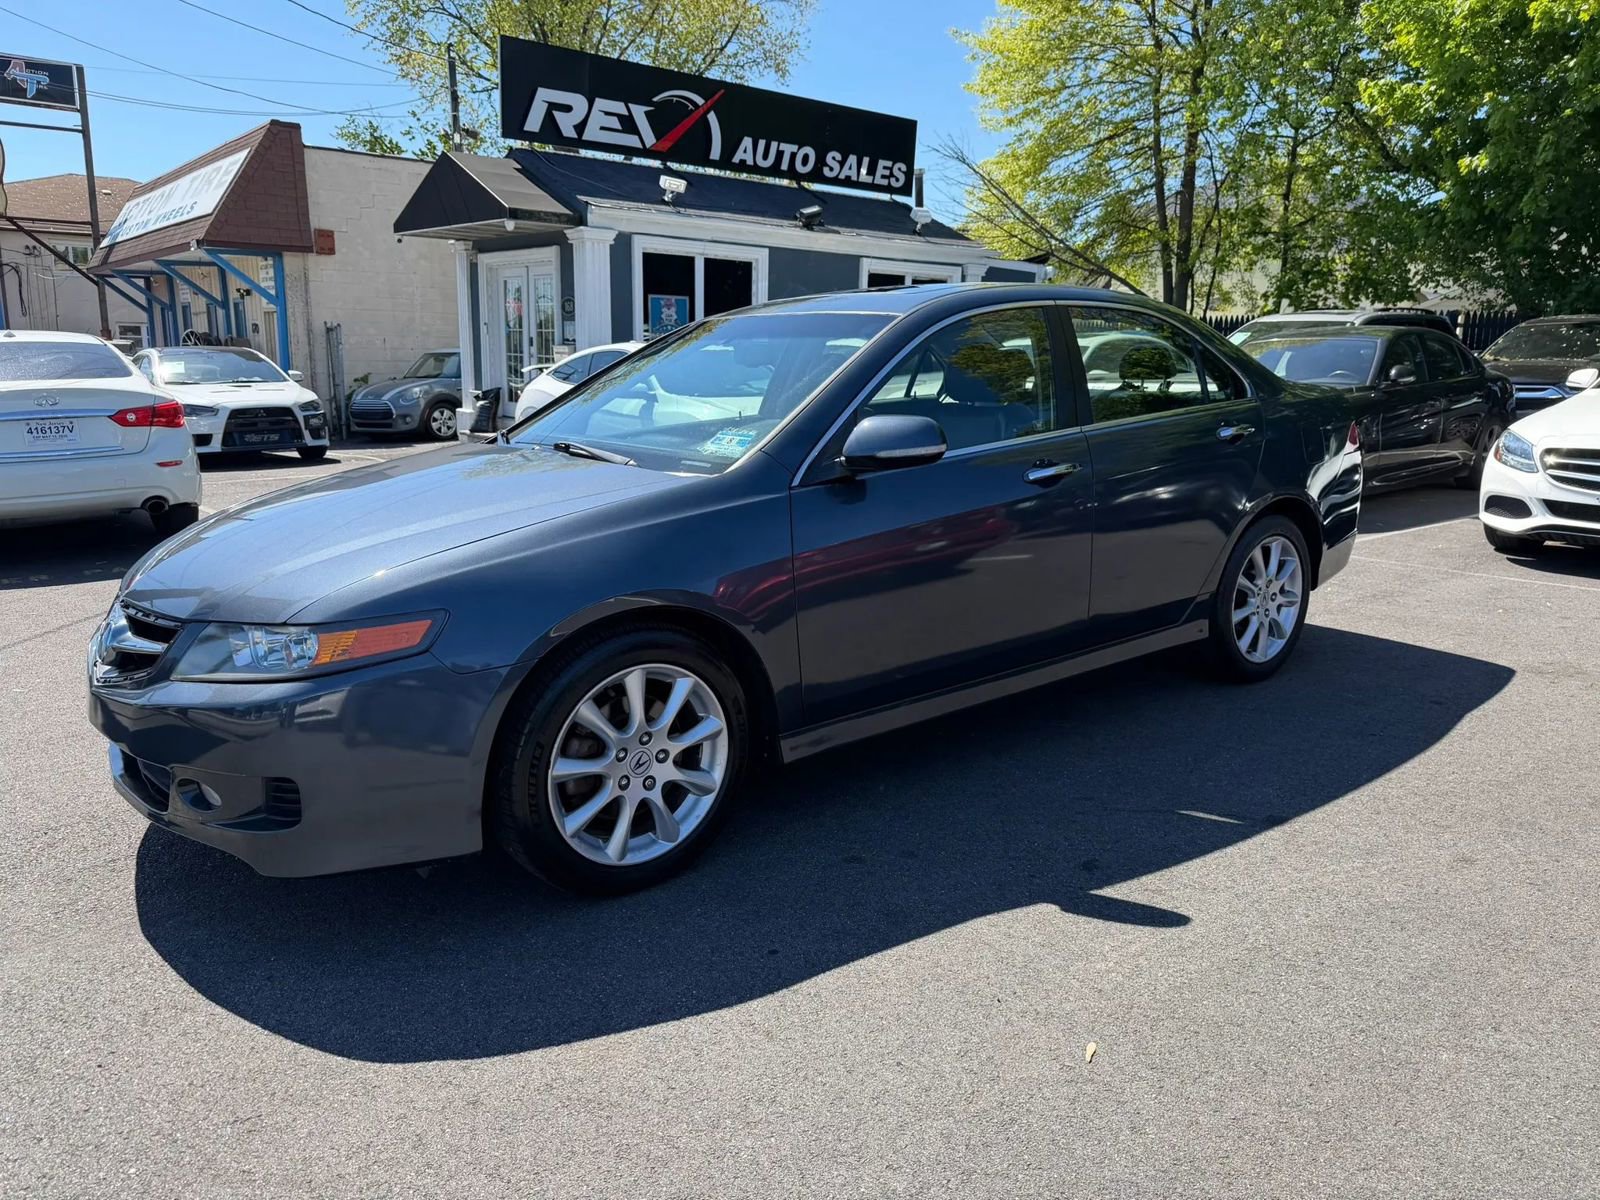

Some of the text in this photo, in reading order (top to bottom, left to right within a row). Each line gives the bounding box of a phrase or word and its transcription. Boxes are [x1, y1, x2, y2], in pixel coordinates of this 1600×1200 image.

[732, 136, 907, 188] AUTO SALES
[26, 425, 75, 435] 416137V
